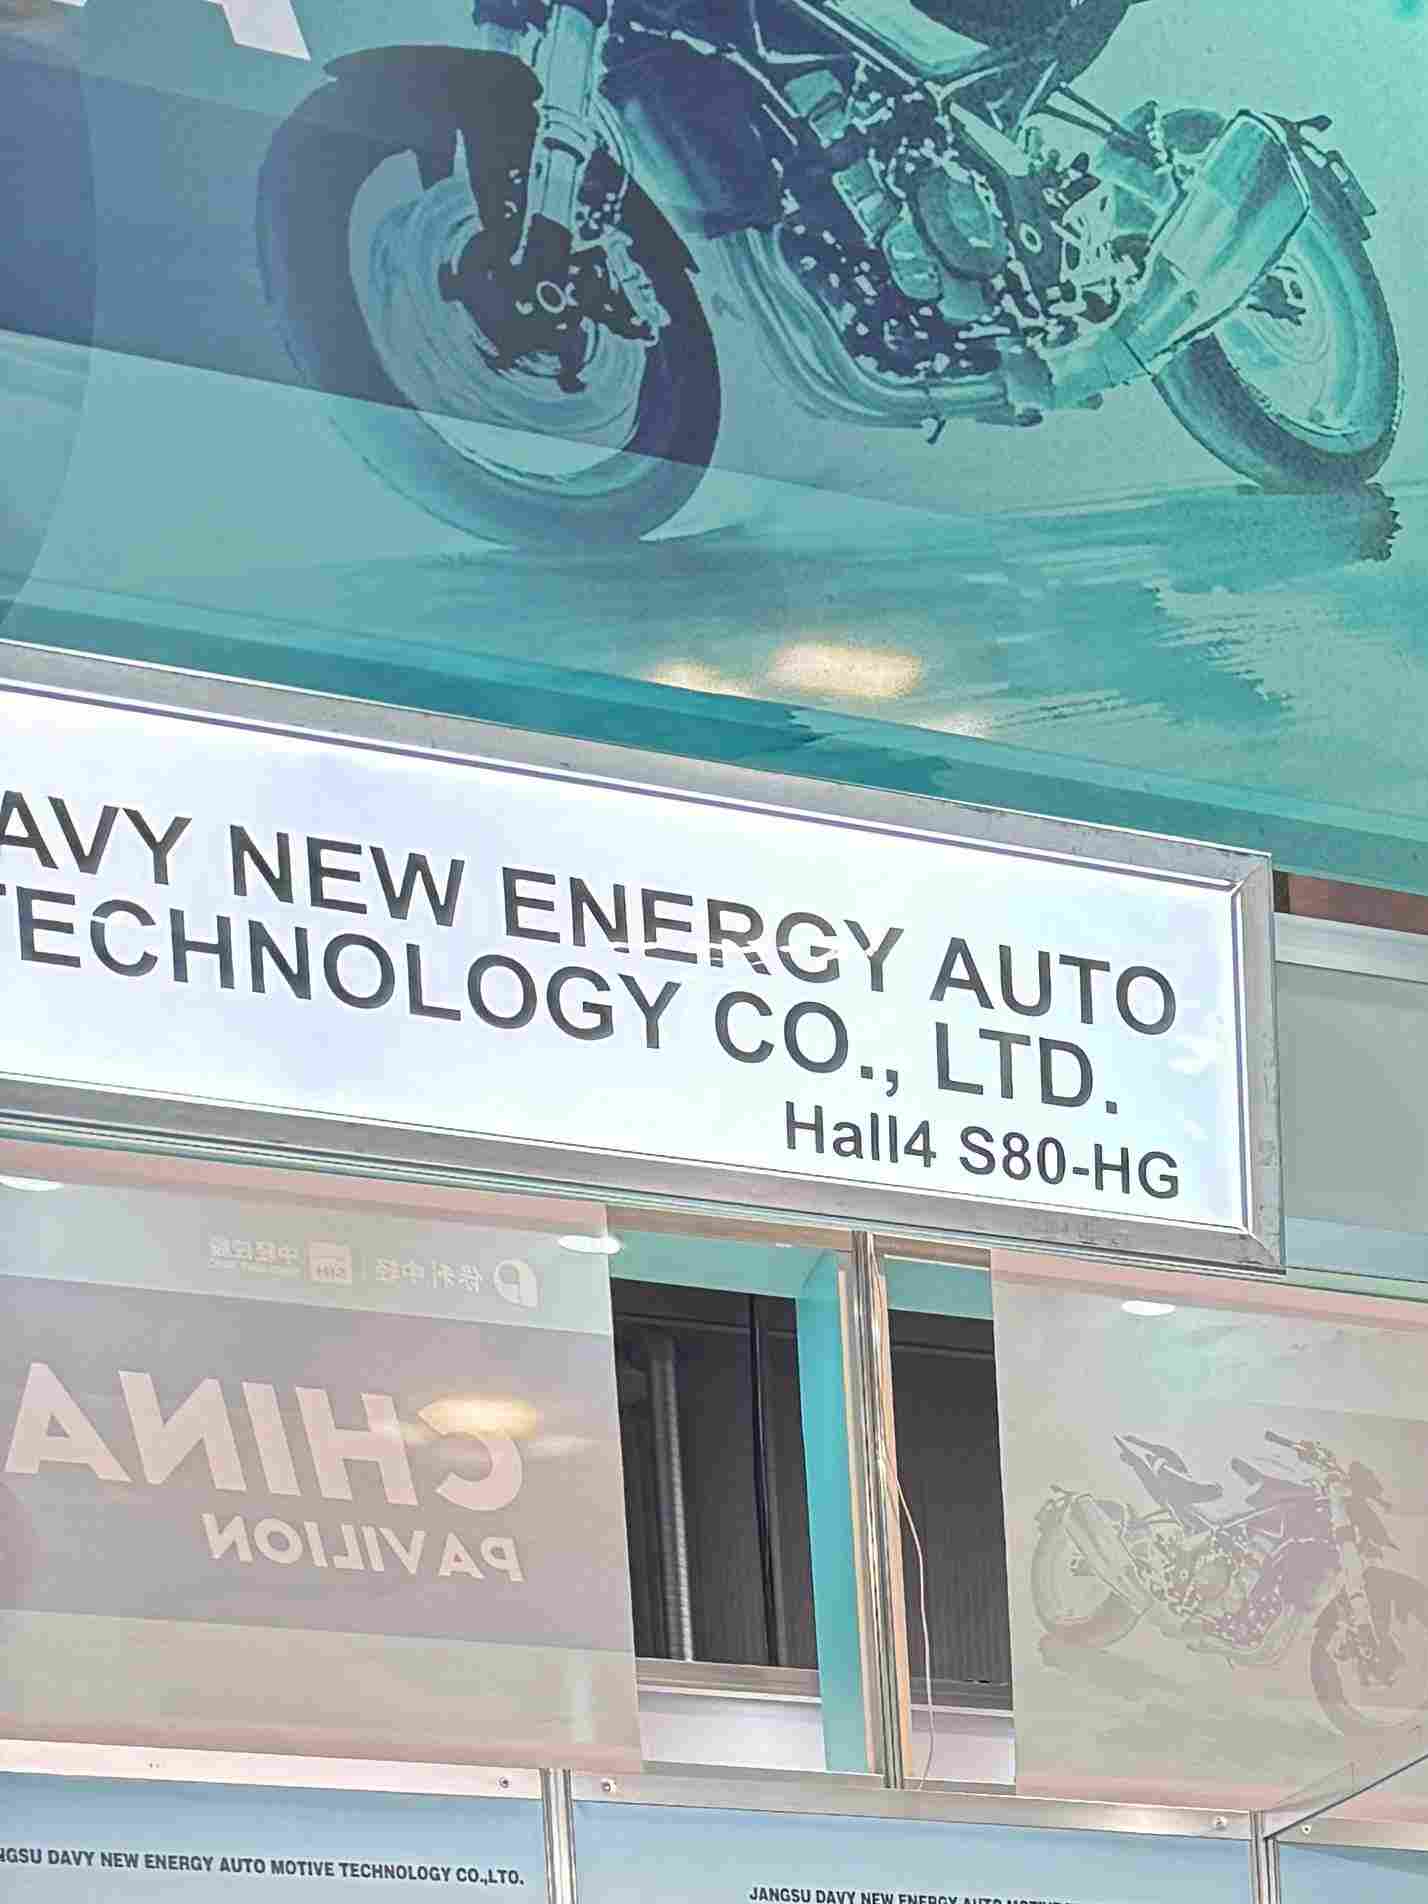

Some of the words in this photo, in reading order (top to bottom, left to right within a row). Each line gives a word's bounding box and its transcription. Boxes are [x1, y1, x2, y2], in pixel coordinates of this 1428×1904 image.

[230, 824, 465, 928] NEW
[504, 871, 905, 994] ENERGY
[930, 937, 1177, 1038] AUTO
[0, 884, 678, 1051] ECHNOLOGY
[713, 990, 899, 1098] CO.,
[935, 1026, 1118, 1114] LTD.
[785, 1101, 936, 1169] Hall4
[960, 1125, 1180, 1200] S80-HG
[48, 1849, 95, 1867] DAVY
[100, 1852, 139, 1869] NEW
[145, 1854, 214, 1872] ENERGY
[219, 1857, 266, 1874] AUTO
[271, 1859, 333, 1877] MOTIVE
[338, 1862, 451, 1882] TECHNOLOGY
[749, 1885, 812, 1904] JANGSU
